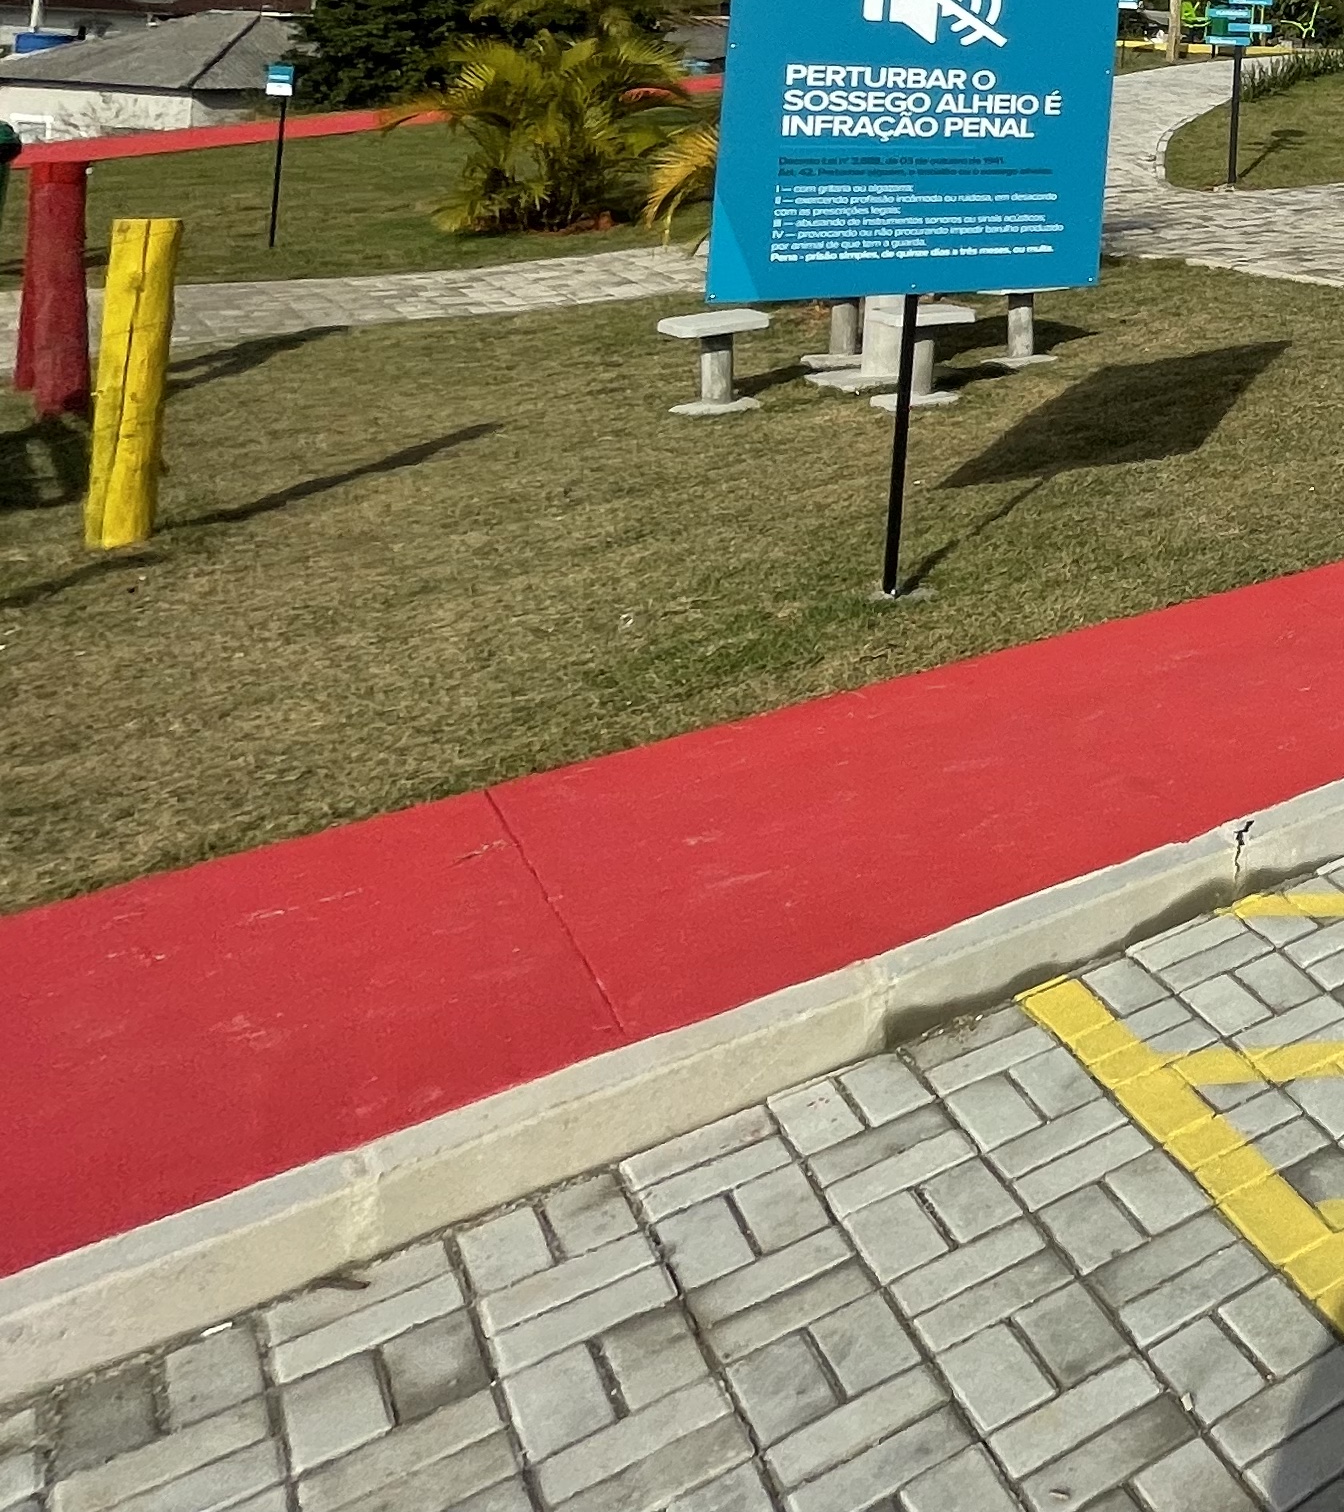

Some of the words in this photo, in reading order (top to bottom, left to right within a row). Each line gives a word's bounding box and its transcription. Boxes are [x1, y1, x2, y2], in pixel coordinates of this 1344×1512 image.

[785, 64, 967, 90] PERTURBAR
[971, 69, 996, 90] O
[783, 89, 932, 114] SOSSEGO
[935, 92, 1039, 115] ALHEIO
[1044, 90, 1063, 116] É
[781, 111, 939, 143] INFRAÇÃO
[944, 117, 1035, 138] PENAL
